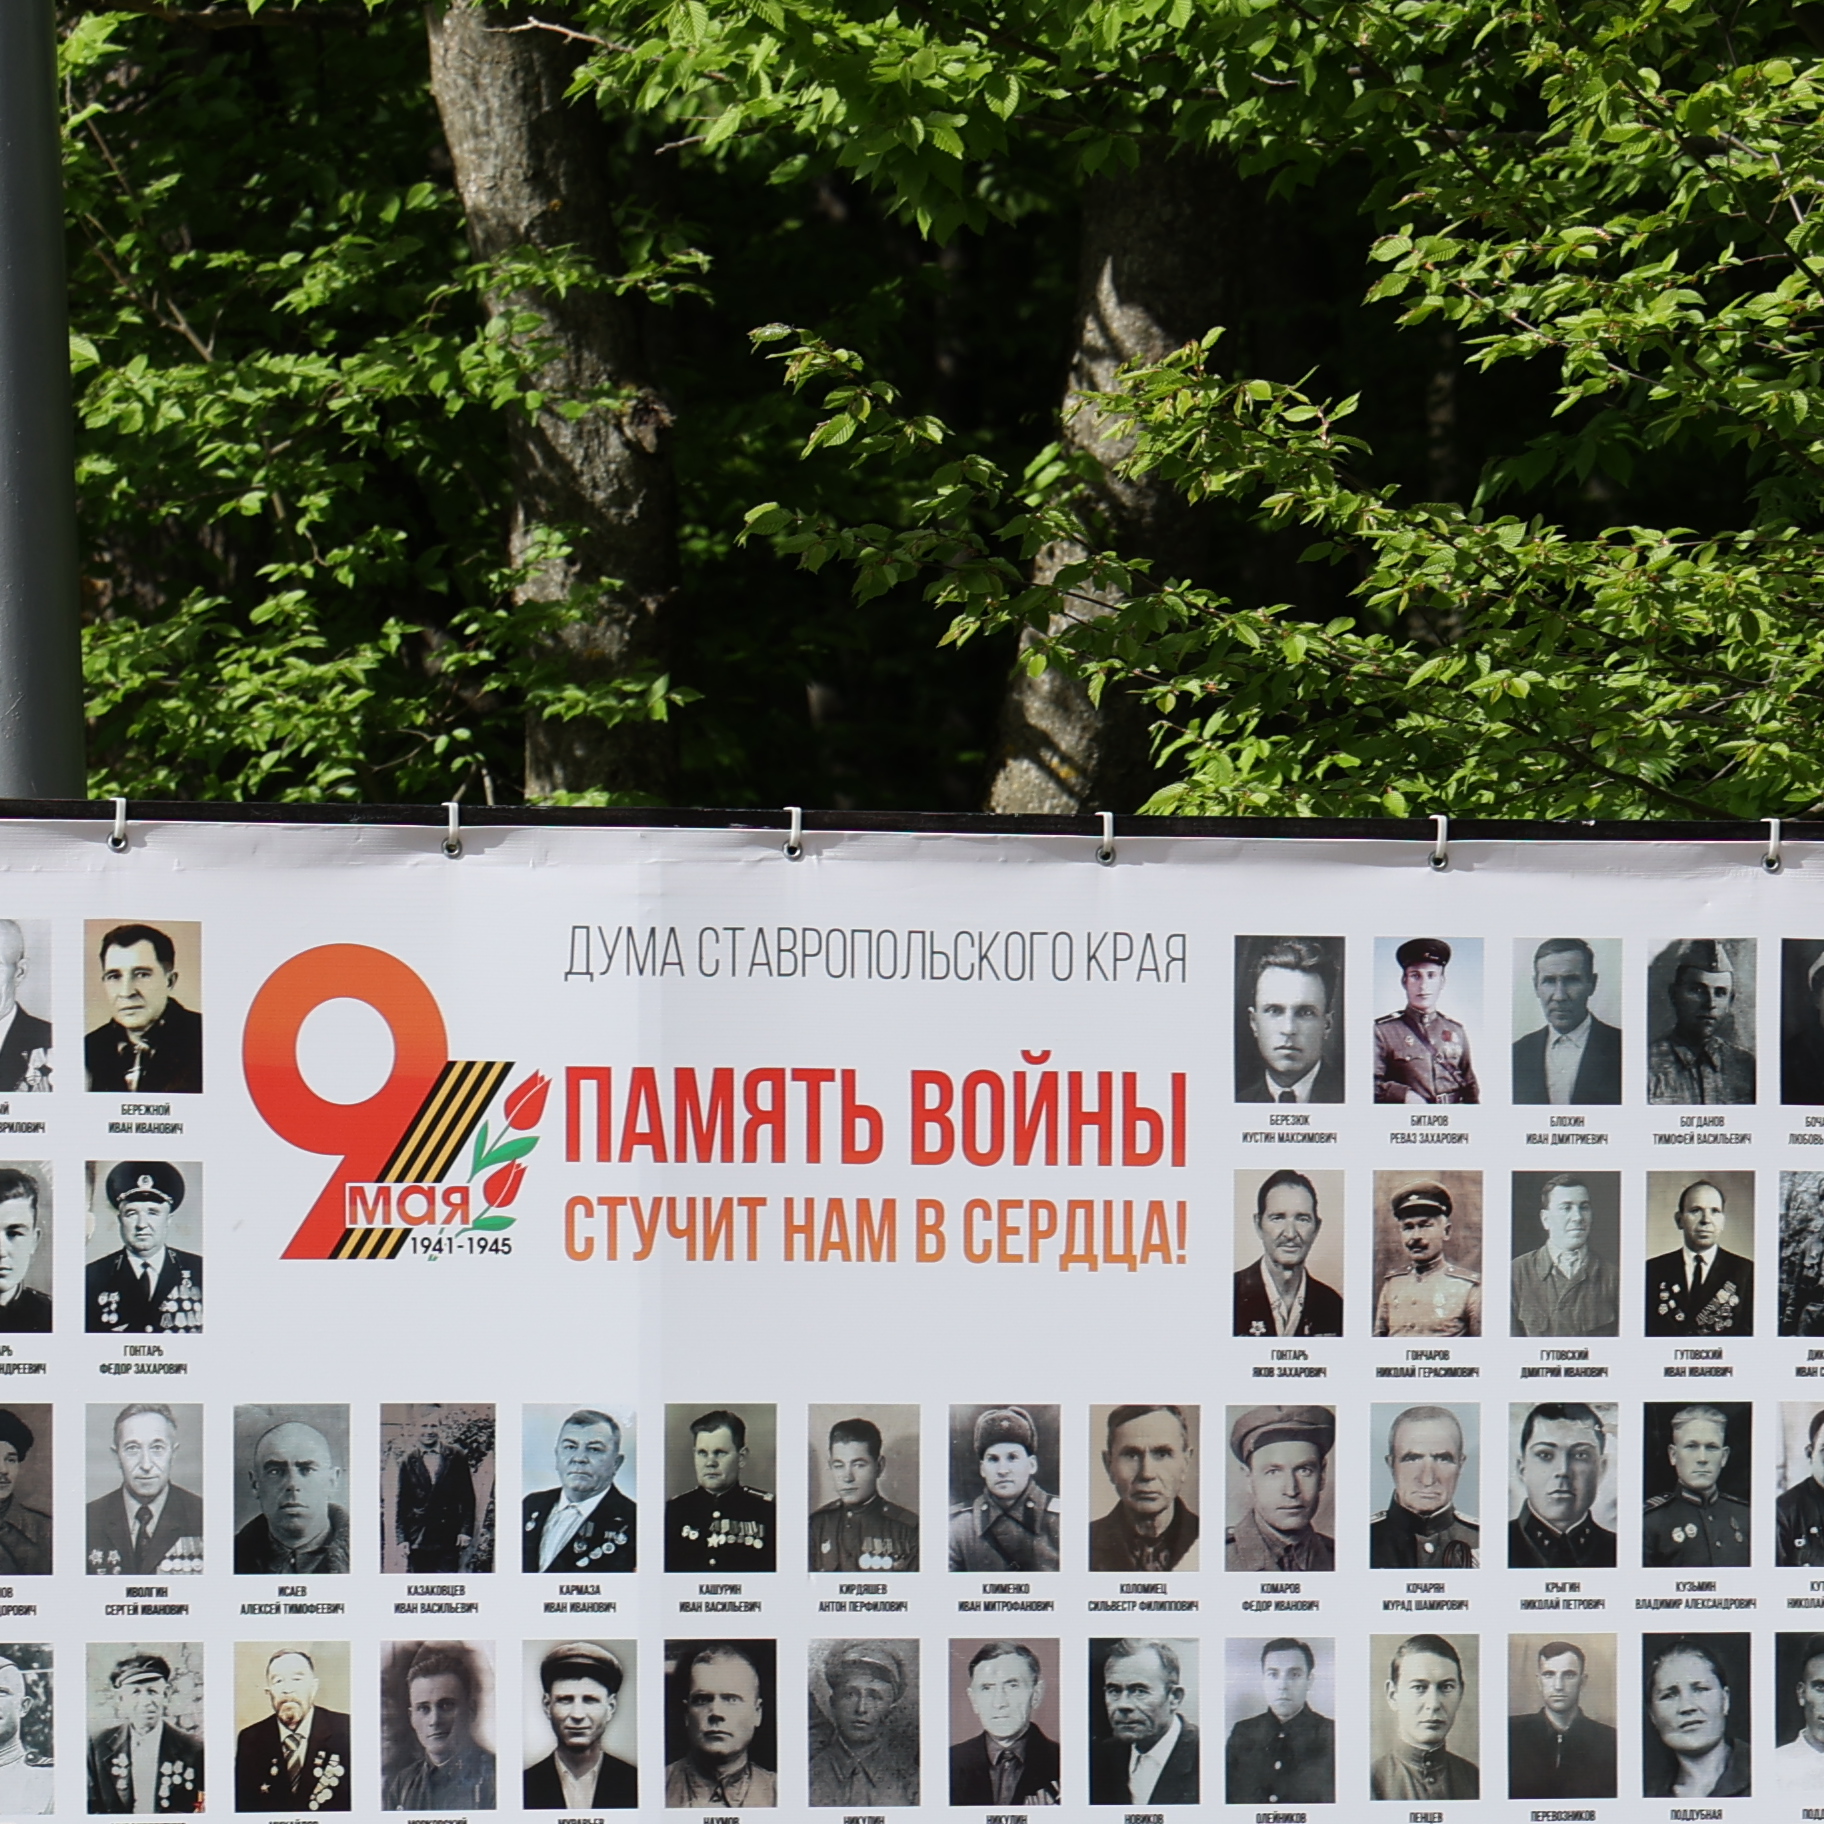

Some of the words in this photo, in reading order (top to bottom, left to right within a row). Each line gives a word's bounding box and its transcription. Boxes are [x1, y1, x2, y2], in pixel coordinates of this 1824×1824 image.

[564, 925, 685, 982] ДУМА
[698, 926, 1074, 983] СТАВРОПОЛЬСКОГО
[1086, 931, 1186, 983] КРАЯ
[242, 943, 448, 1259] 9
[121, 1102, 171, 1116] БЕРЕЖНОЙ
[565, 1066, 884, 1165] ПАМЯТЬ
[911, 1050, 1186, 1168] ВОЙНЫ
[108, 1122, 133, 1134] ИВАН
[134, 1122, 184, 1135] ИВАНОВИЧ
[1242, 1131, 1276, 1143] ИУСТИН
[1277, 1132, 1337, 1144] МАКСИМОВИЧ
[1652, 1131, 1695, 1145] ТИМОФЕЙ
[1696, 1132, 1752, 1145] ВАСИЛЬЕВИЧ
[348, 1184, 470, 1226] мая
[565, 1195, 767, 1262] СТУЧИТ
[784, 1197, 897, 1263] НАМ
[916, 1198, 946, 1263] В
[964, 1198, 1187, 1273] СЕРДЦА!
[411, 1236, 512, 1256] 1941-1945
[99, 1362, 133, 1376] ФЕДОР
[133, 1362, 188, 1375] ЗАХАРОВИЧ
[1252, 1366, 1276, 1378] ЯКОВ
[1276, 1366, 1327, 1378] ЗАХАРОВИЧ
[1795, 1366, 1818, 1378] ИВАН
[406, 1584, 466, 1597] КАЗАКОВЦЕВ
[698, 1583, 742, 1596] КАШУРИН
[394, 1602, 418, 1614] ИВАН
[420, 1602, 479, 1614] ВАСИЛЬЕВИЧ
[679, 1601, 703, 1613] ИВАН
[704, 1601, 762, 1613] ВАСИЛЬЕВИЧ
